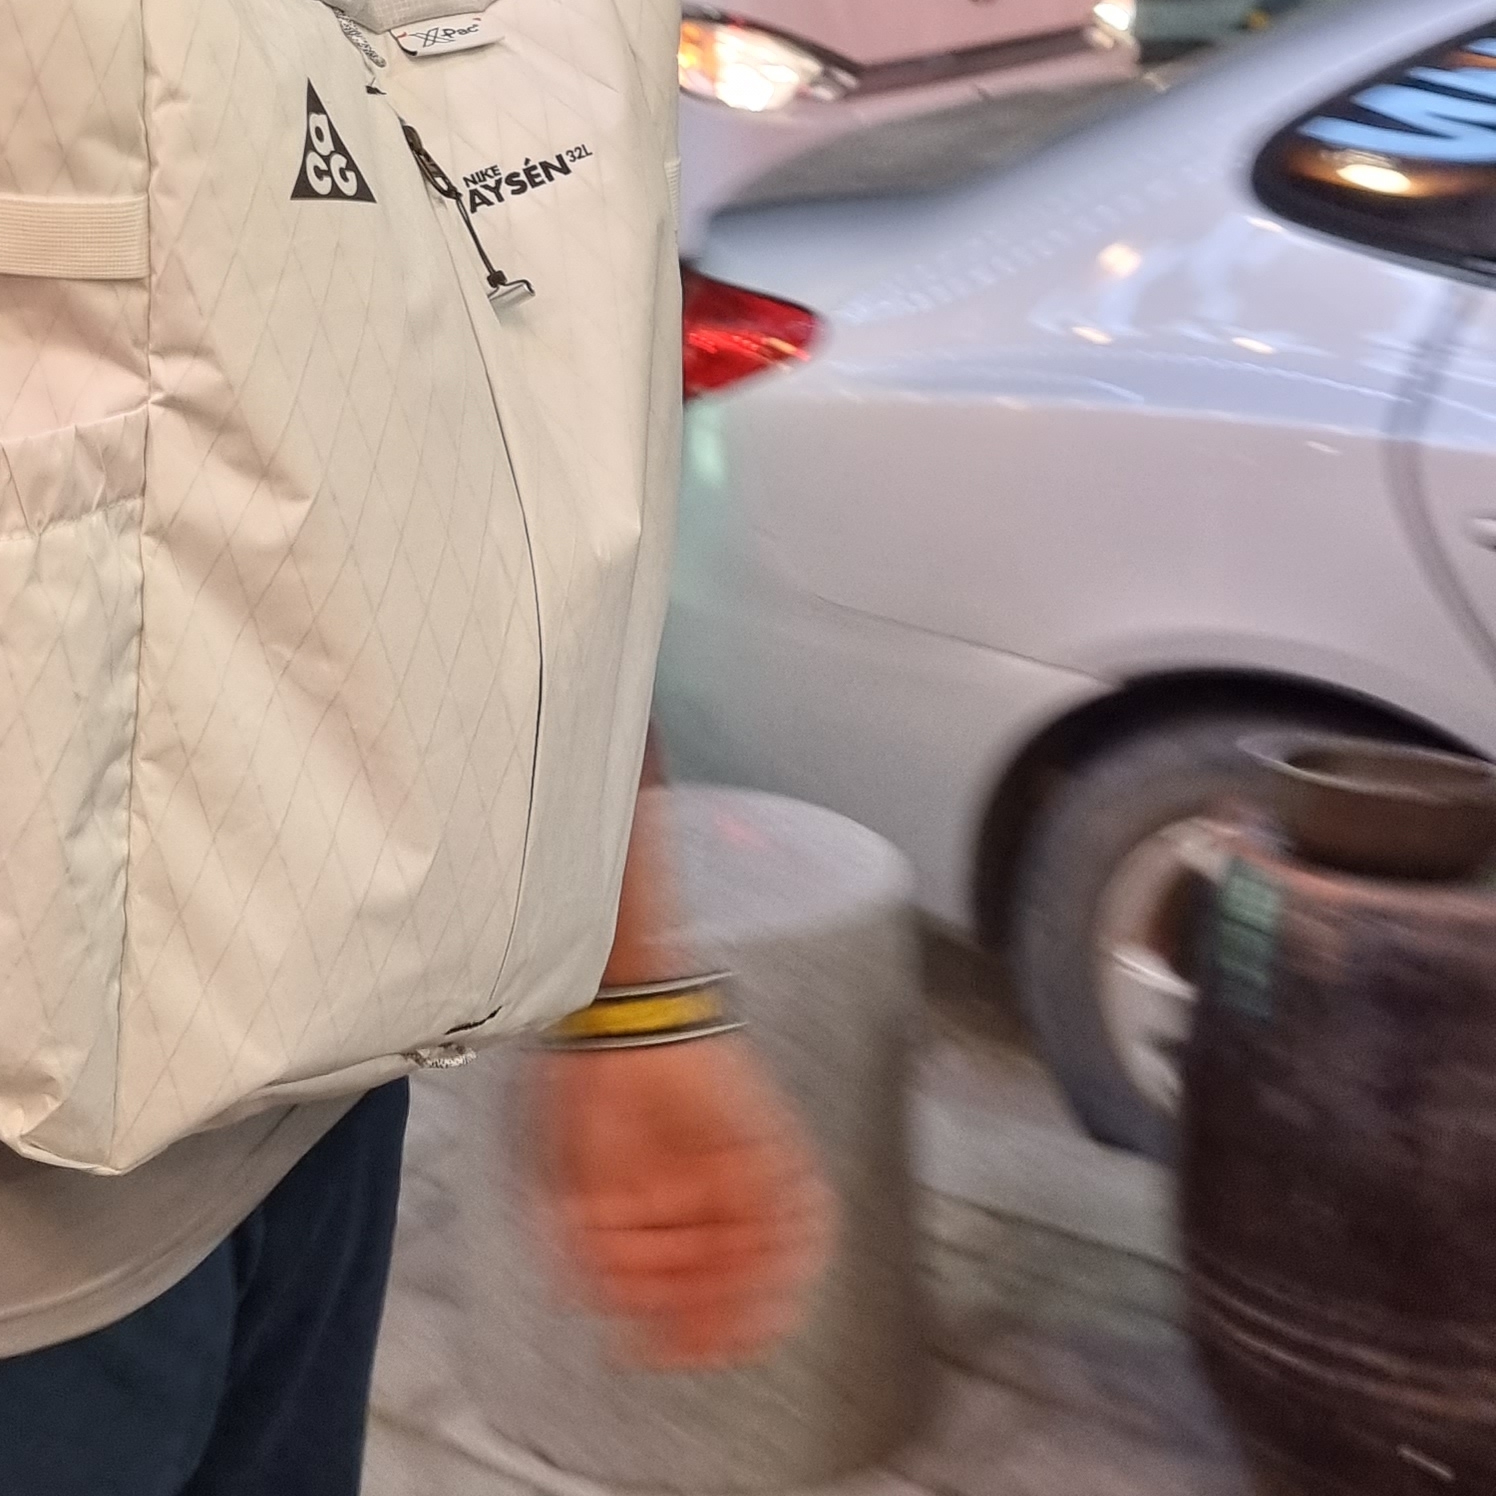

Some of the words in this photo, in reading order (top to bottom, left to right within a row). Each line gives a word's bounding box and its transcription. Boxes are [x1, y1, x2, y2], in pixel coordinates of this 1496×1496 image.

[463, 164, 502, 188] NIKE
[468, 157, 572, 214] AYSÉN
[565, 144, 593, 163] 32L
